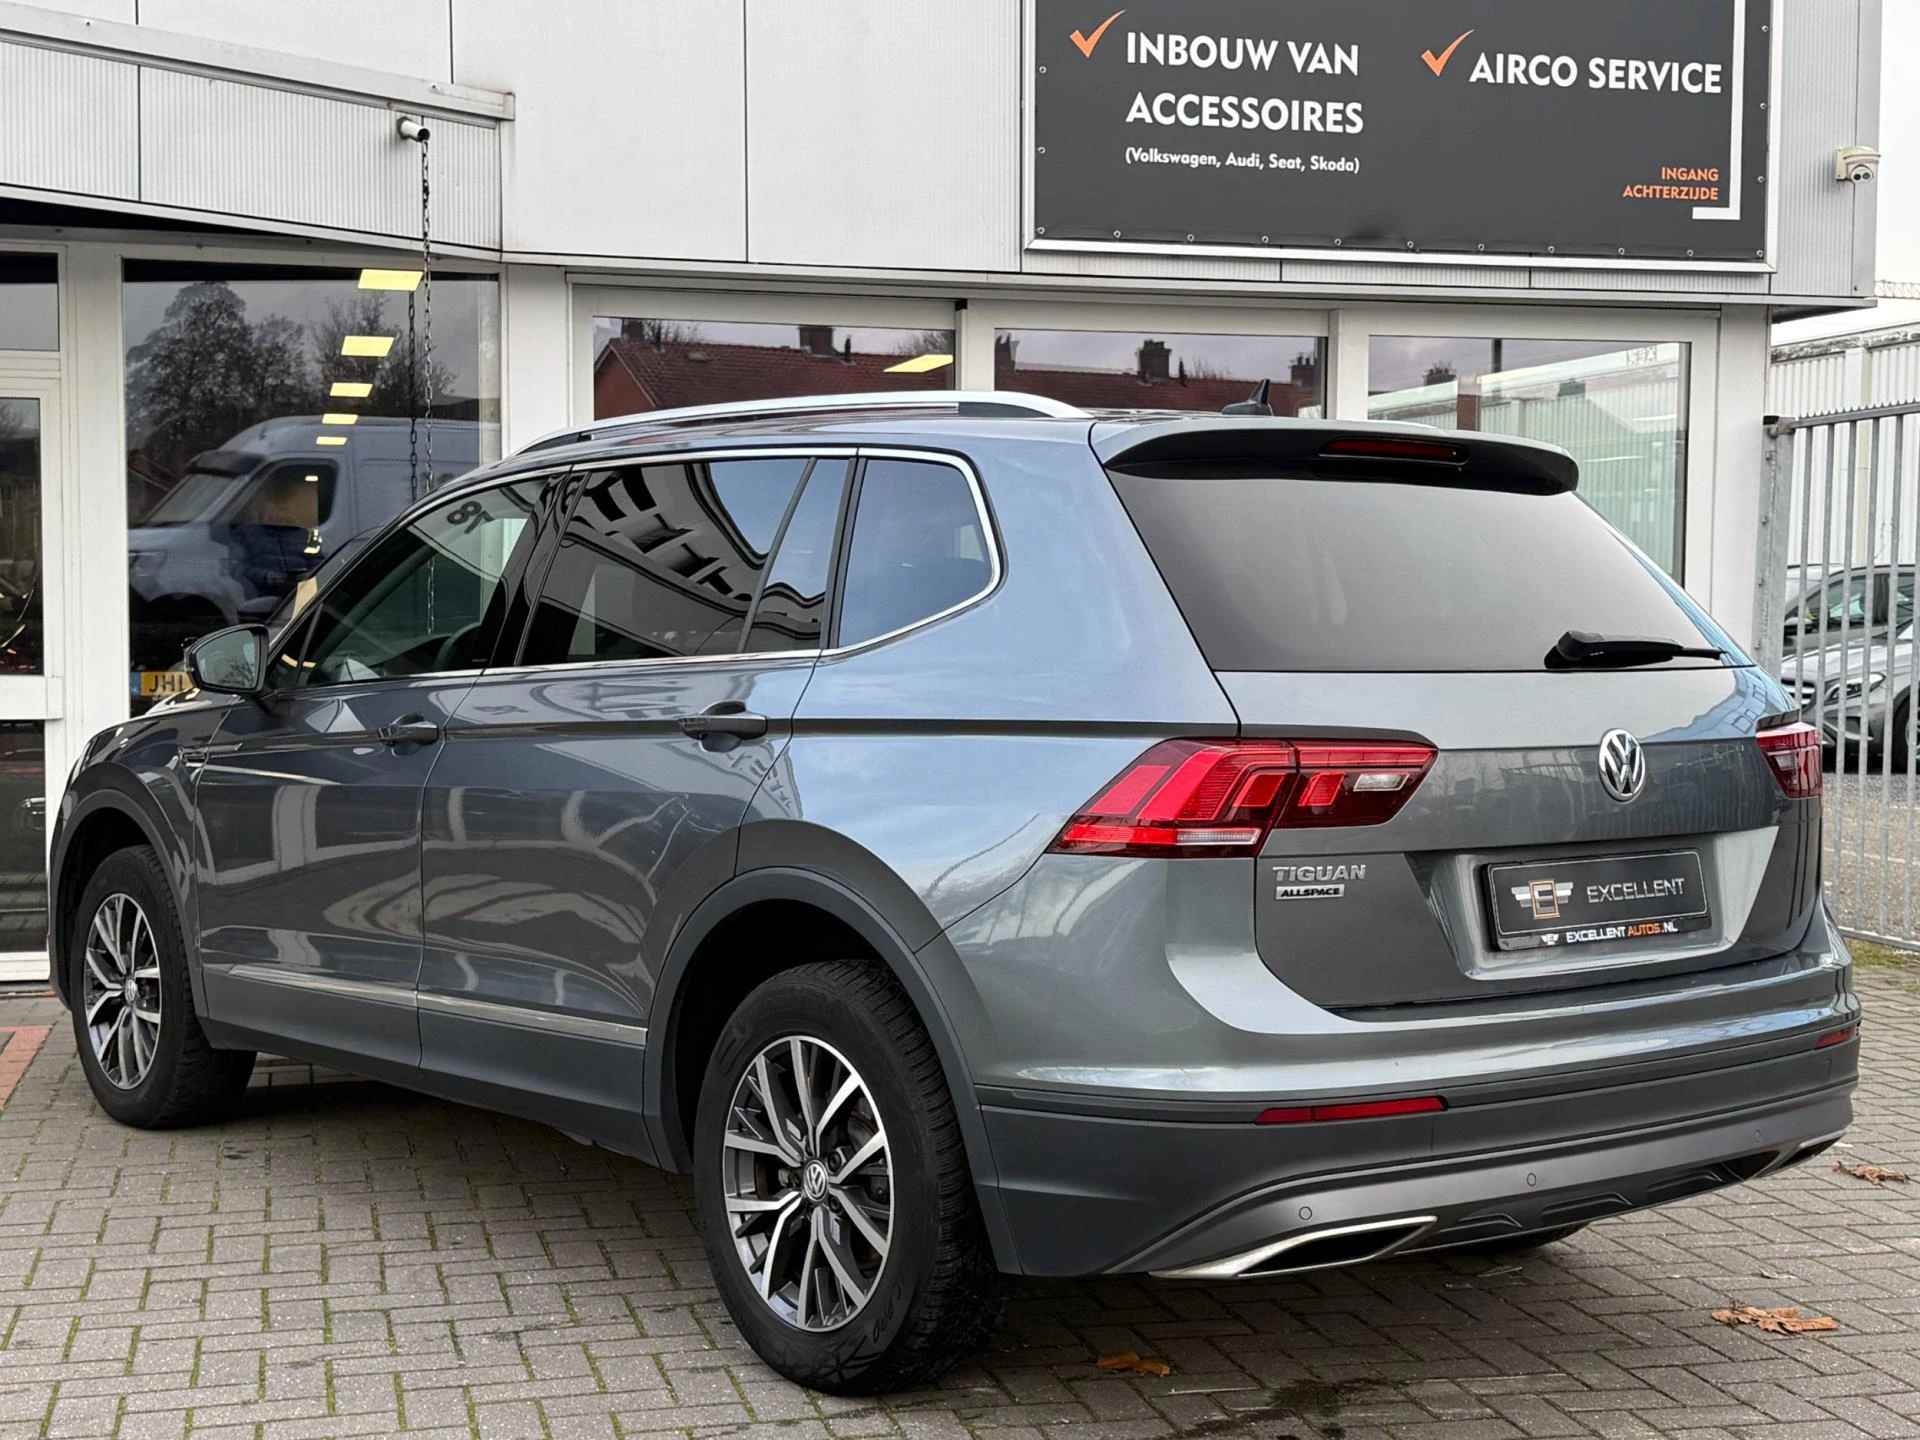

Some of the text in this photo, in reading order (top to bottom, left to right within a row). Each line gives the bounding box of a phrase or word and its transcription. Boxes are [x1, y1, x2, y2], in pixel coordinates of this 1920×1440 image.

[1126, 31, 1360, 76] INBOUW VAN
[1468, 52, 1722, 94] AIRCO SERVICE
[1125, 91, 1364, 134] ACCESSOIRES
[1125, 146, 1361, 175] (Volkswagen, Audi, Seat, Skoda)
[1661, 166, 1719, 182] INGANG
[1622, 184, 1719, 201] ACHTERZIJDE
[1272, 864, 1367, 881] TIGUAN
[1280, 887, 1340, 898] ALLSPACE
[1586, 877, 1685, 904] EXCELLENT
